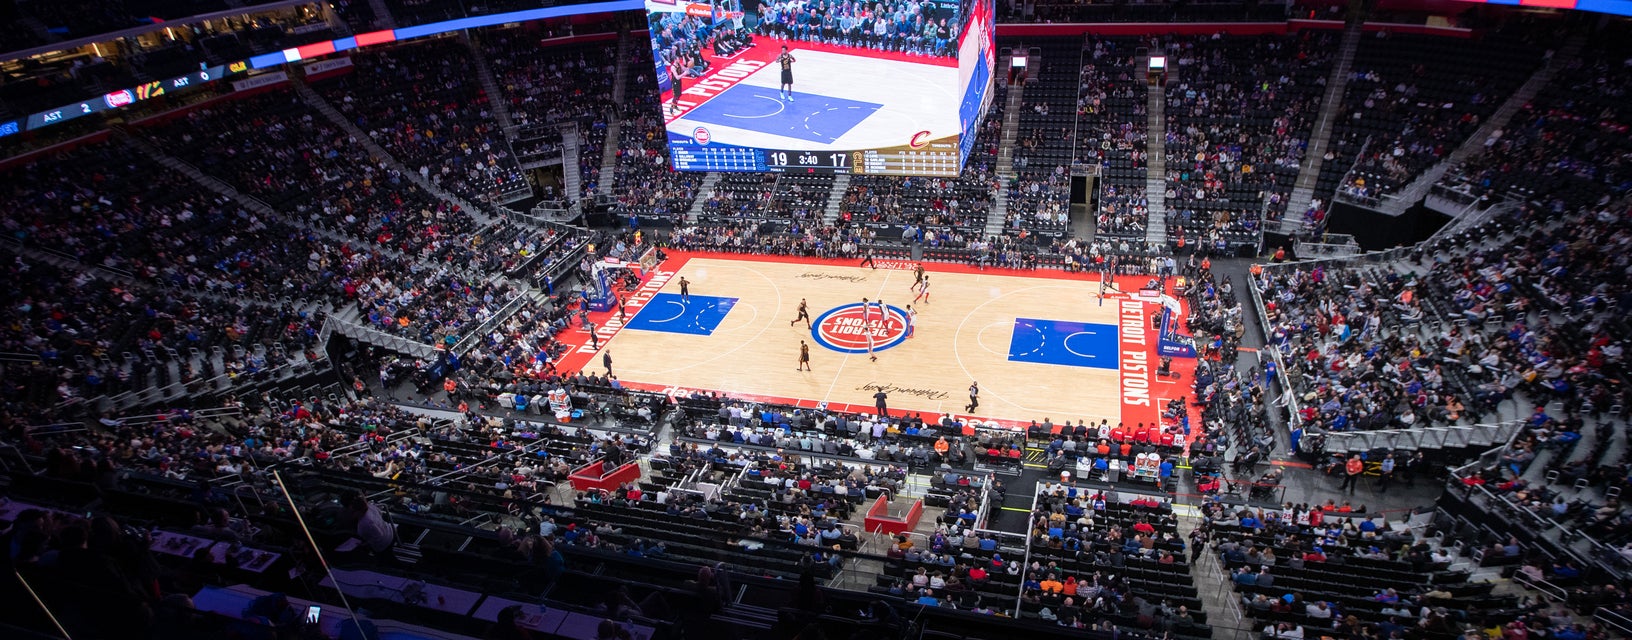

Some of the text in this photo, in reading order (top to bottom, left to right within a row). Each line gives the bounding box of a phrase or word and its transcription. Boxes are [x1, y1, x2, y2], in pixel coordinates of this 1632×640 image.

[173, 72, 209, 87] AST 0
[681, 59, 766, 97] PISTONS
[44, 111, 62, 122] AST
[81, 103, 91, 113] 2
[771, 152, 788, 166] 19
[799, 155, 818, 165] 3:40
[830, 153, 847, 167] 17
[853, 151, 863, 174] CLE
[575, 271, 676, 354] DETROIT PISTONS
[1121, 301, 1150, 406] DETROIT PISTONS
